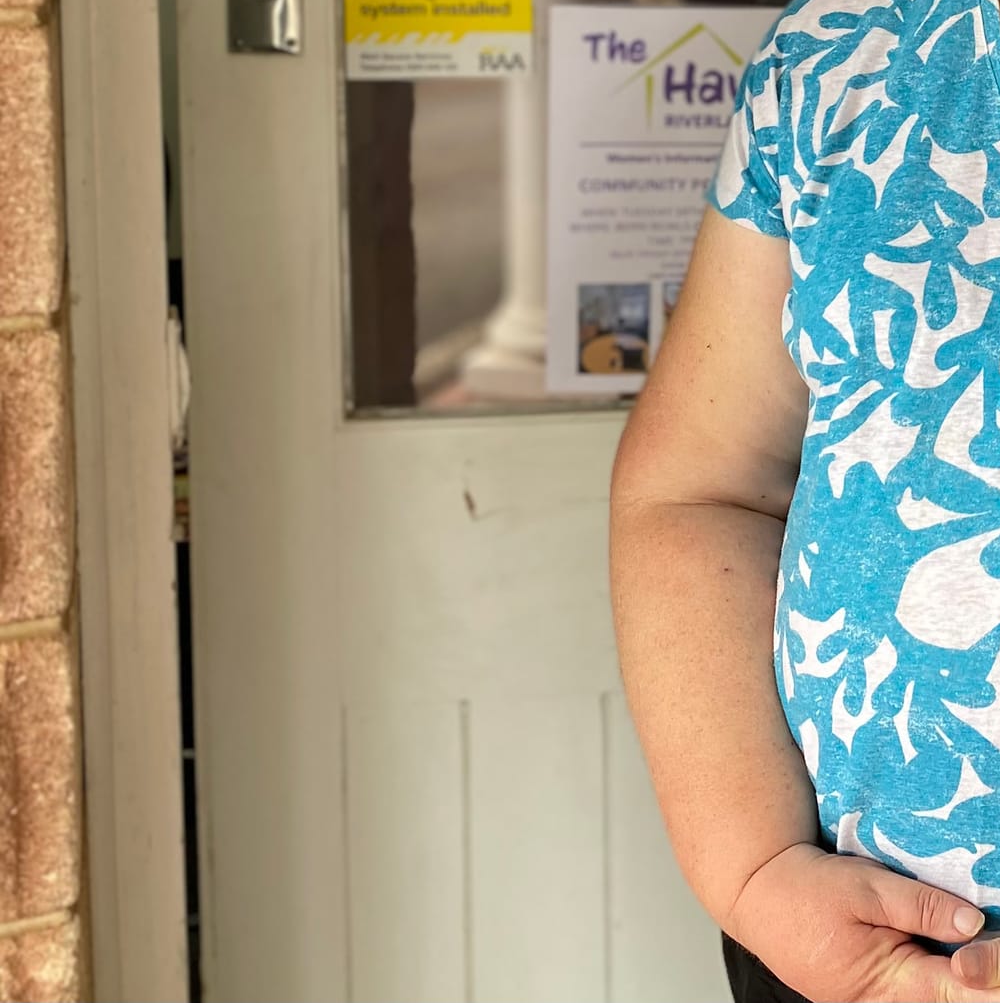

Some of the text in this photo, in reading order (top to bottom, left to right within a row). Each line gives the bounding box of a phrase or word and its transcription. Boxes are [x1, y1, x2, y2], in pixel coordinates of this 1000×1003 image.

[360, 0, 511, 20] system installed
[582, 30, 647, 64] The
[578, 177, 686, 195] COMMUNITY
